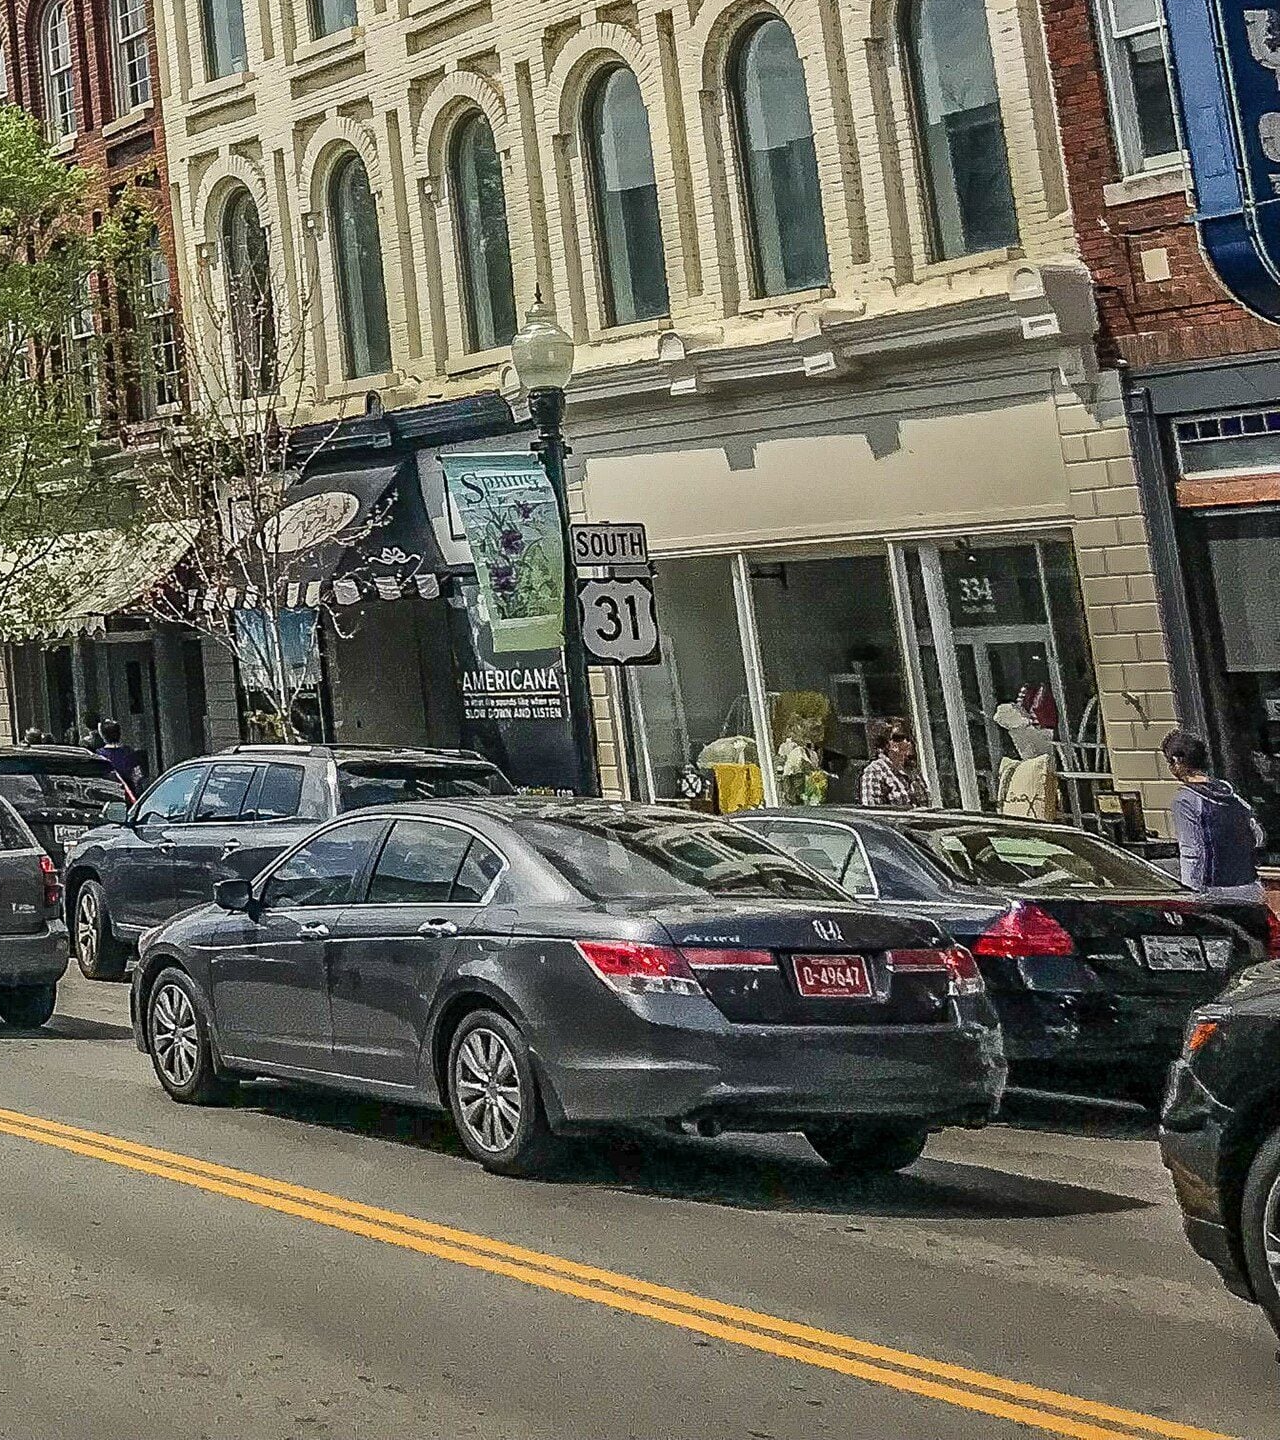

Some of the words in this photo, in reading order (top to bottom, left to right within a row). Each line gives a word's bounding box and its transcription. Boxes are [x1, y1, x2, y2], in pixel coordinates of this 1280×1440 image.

[575, 531, 644, 557] SOUTH
[593, 594, 641, 643] 31
[462, 668, 561, 691] AMERICANA
[532, 707, 562, 718] LISTEN
